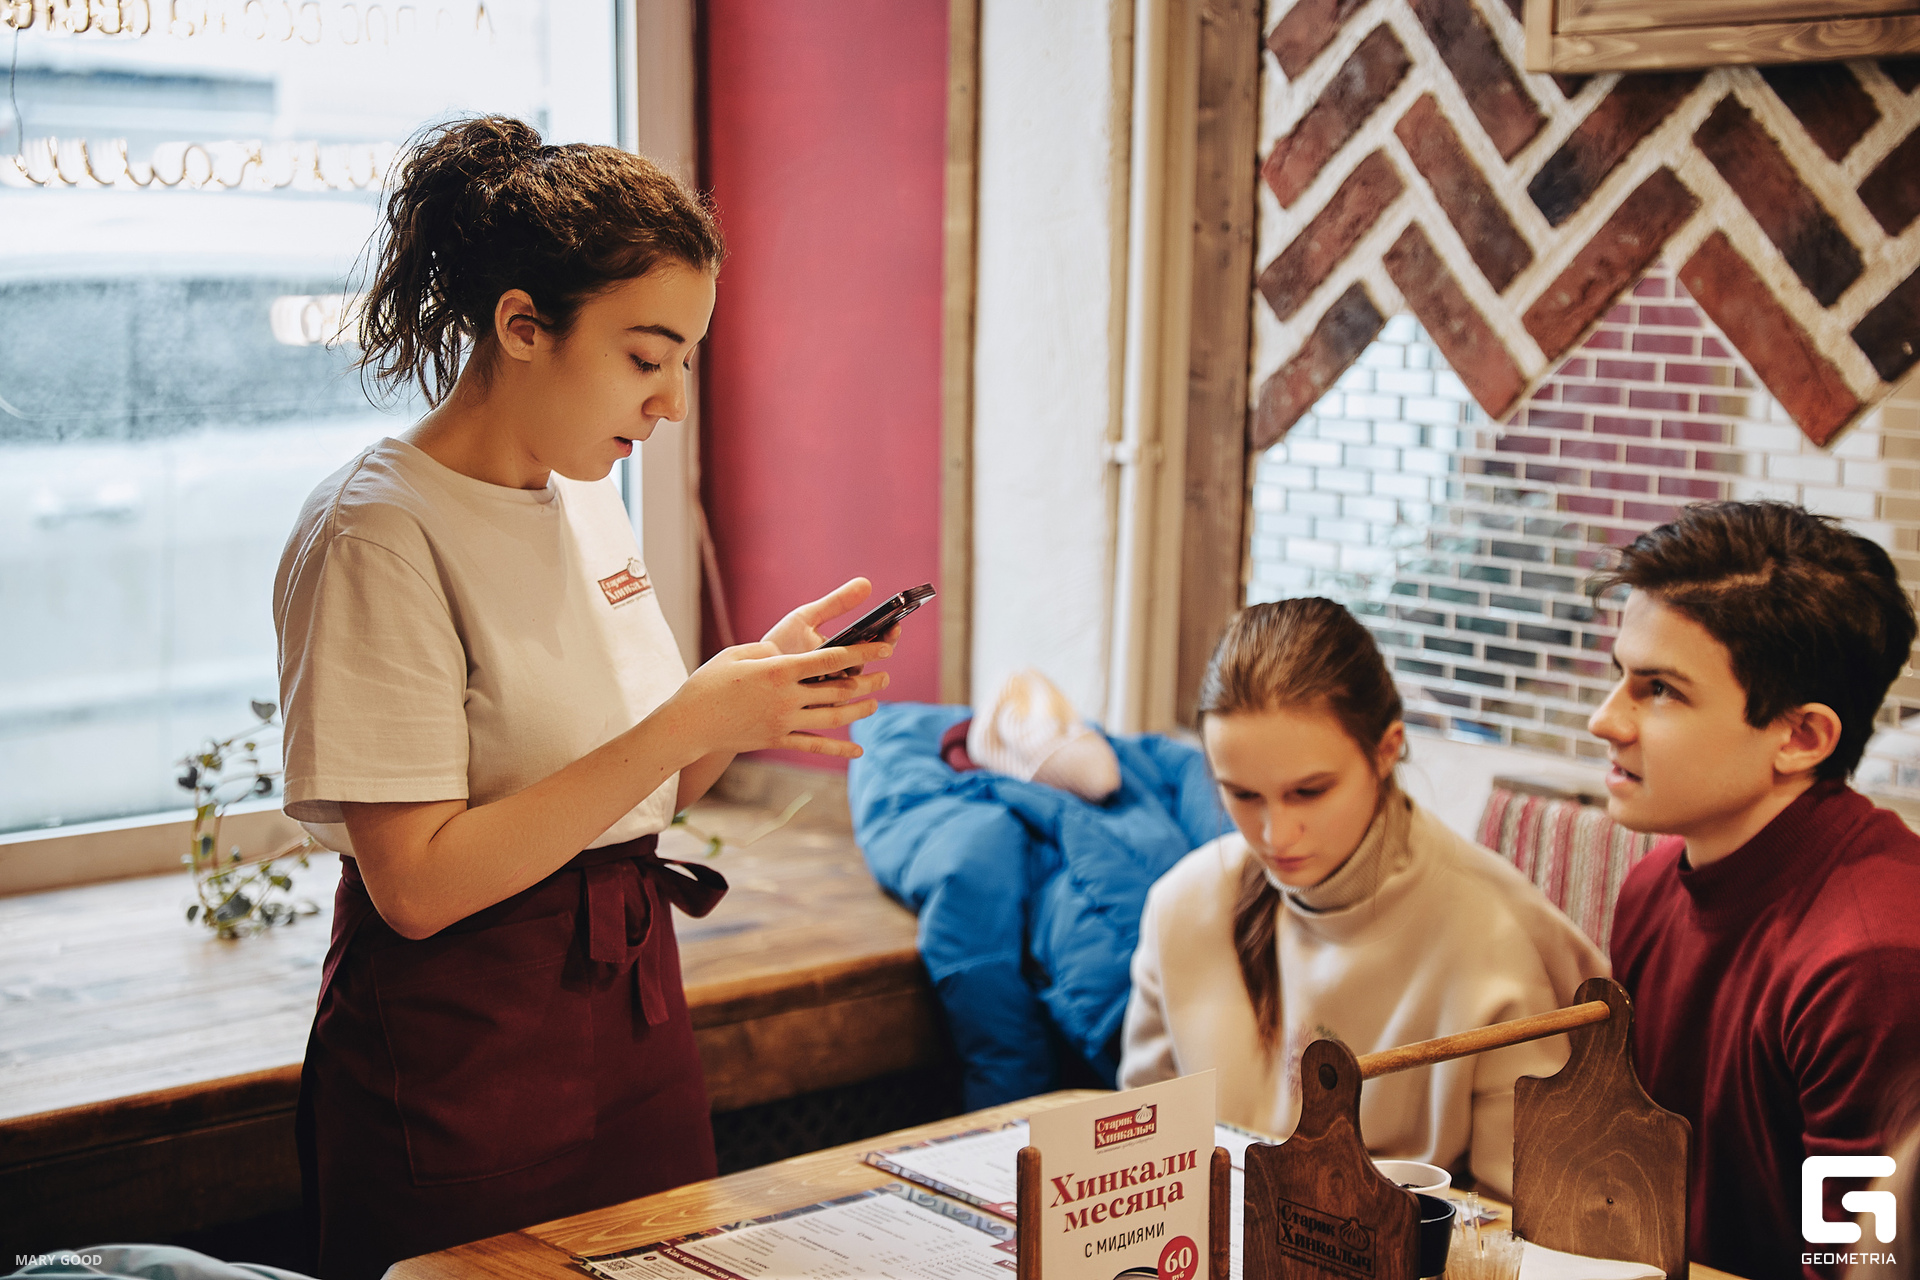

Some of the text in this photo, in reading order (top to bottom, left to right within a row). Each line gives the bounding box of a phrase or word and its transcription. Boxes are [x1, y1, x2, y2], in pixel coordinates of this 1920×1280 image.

[1097, 1116, 1133, 1132] Старик
[1097, 1123, 1155, 1146] Хинкалыч
[1050, 1149, 1197, 1208] Хинкали
[1063, 1181, 1184, 1233] месяца
[1281, 1205, 1335, 1236] Старик
[1097, 1222, 1165, 1254] МИДИЯМИ
[1281, 1223, 1371, 1272] Хинкалыч
[1164, 1247, 1193, 1273] 60
